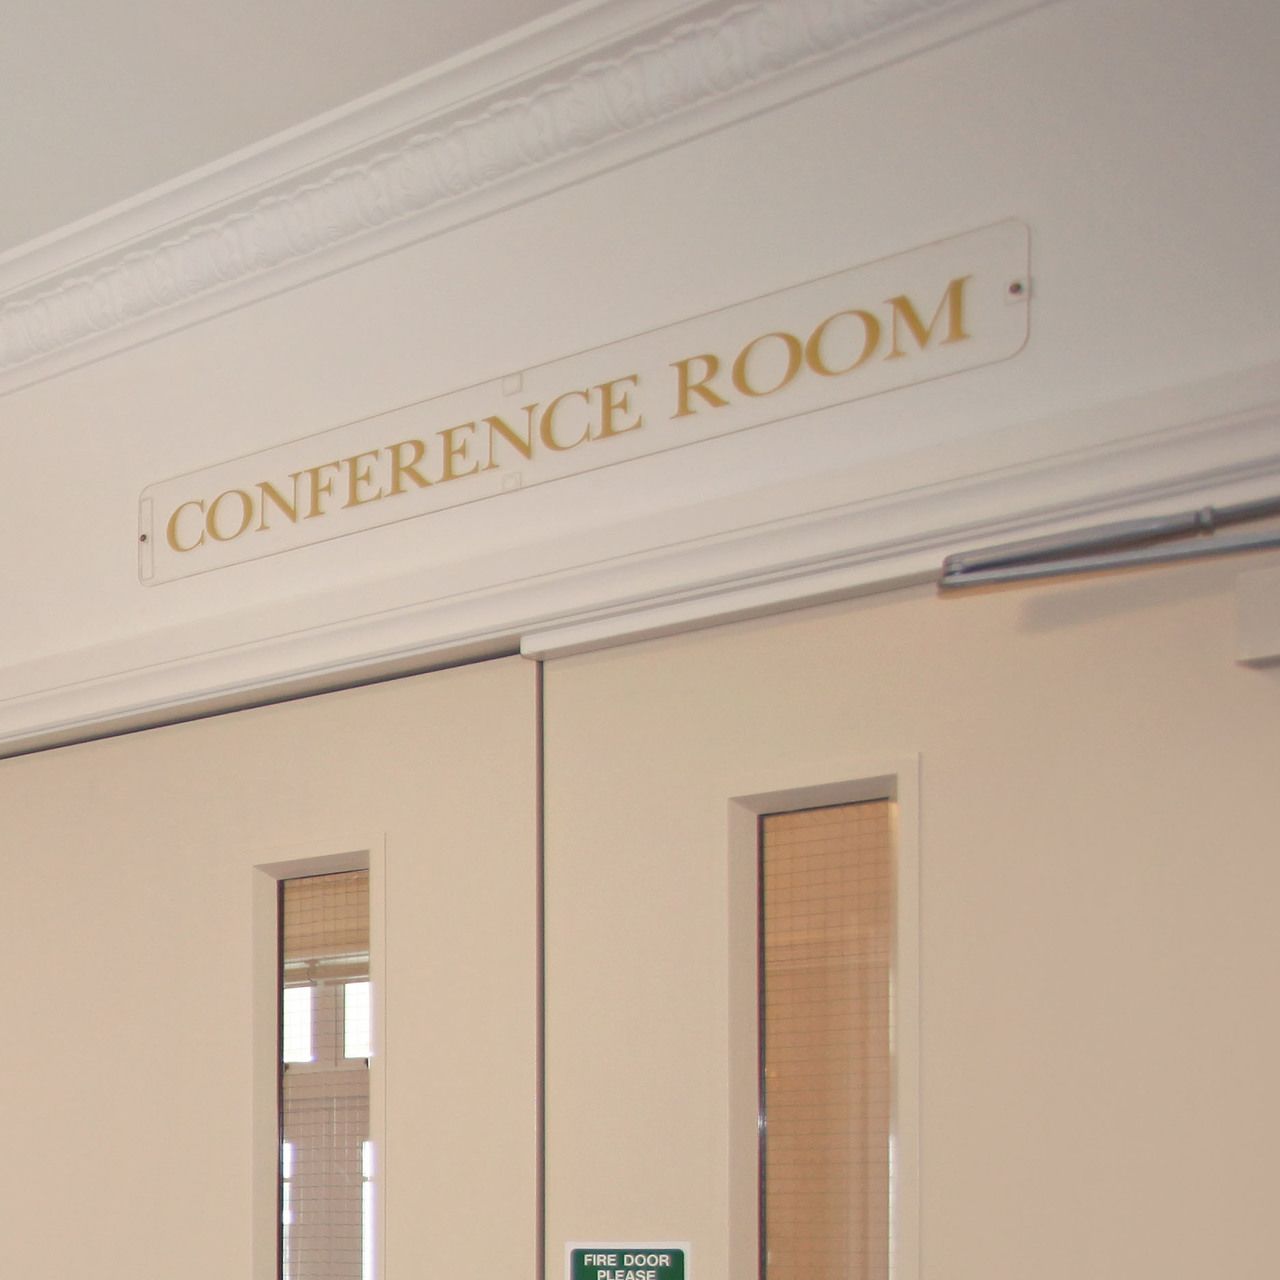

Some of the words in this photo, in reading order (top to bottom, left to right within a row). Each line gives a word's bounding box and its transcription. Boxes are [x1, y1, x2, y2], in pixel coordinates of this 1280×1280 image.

[166, 374, 644, 553] CONFERENCE
[669, 273, 975, 420] ROOM
[583, 1254, 617, 1267] FIRE
[623, 1254, 670, 1267] DOOR
